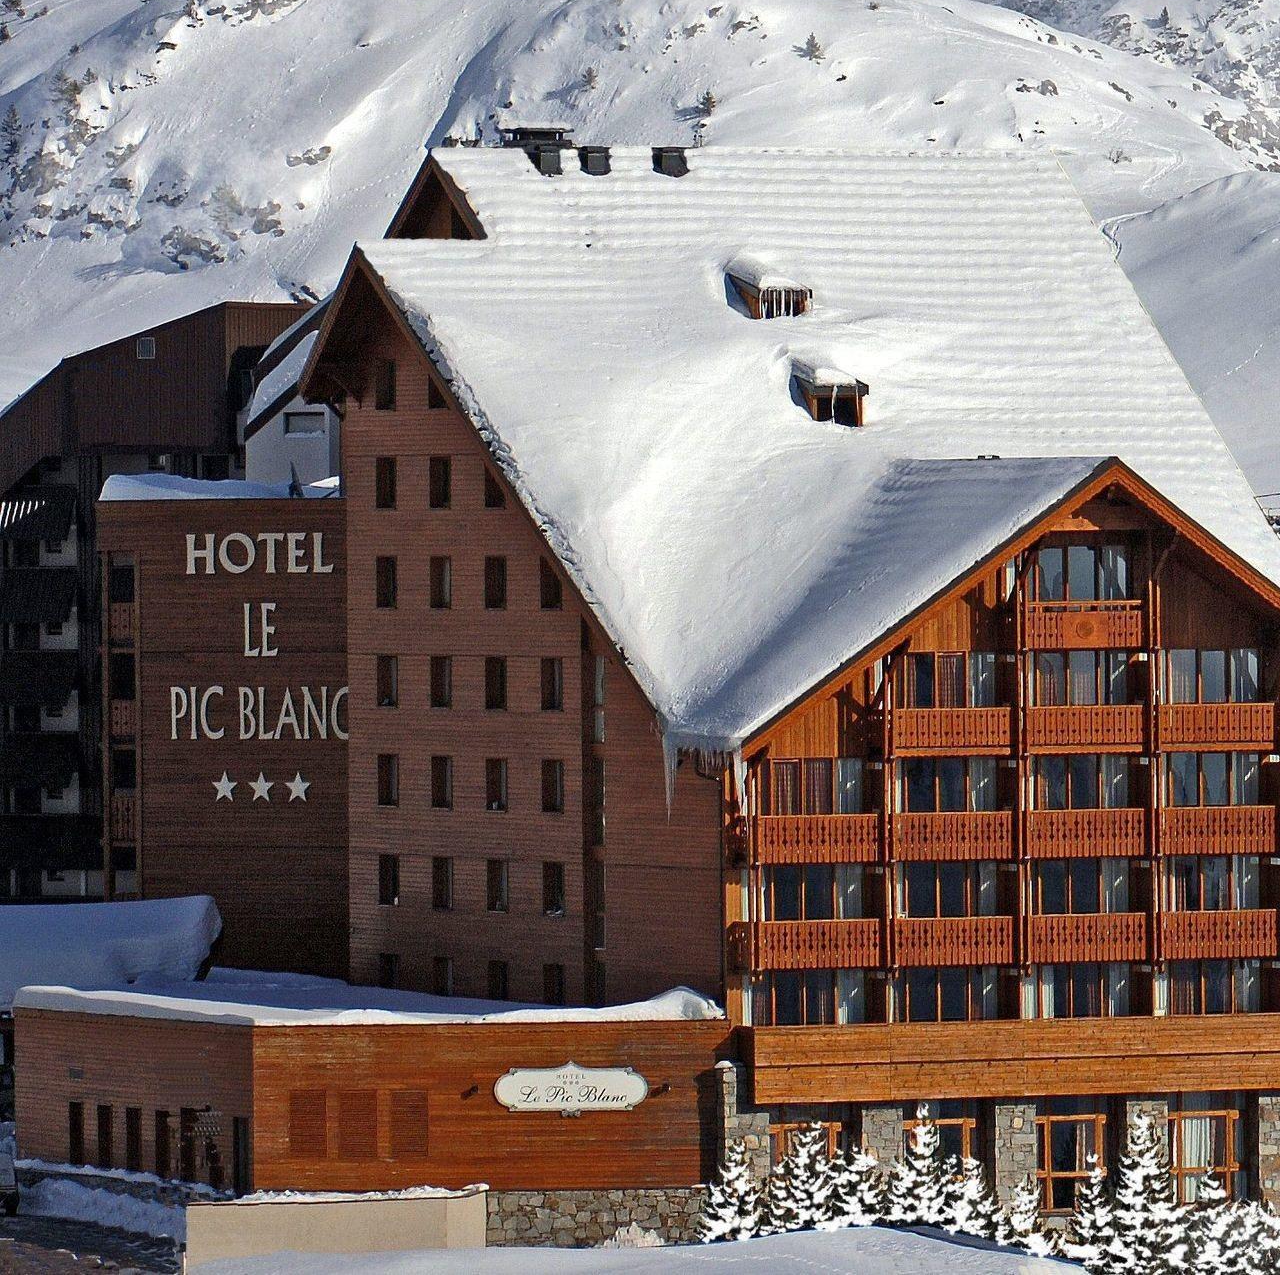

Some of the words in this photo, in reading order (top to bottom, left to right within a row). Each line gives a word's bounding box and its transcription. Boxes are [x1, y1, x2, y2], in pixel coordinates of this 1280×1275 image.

[185, 532, 335, 575] HOTEL
[243, 602, 279, 657] LE
[169, 685, 226, 741] PIC
[518, 1085, 541, 1103] Le
[545, 1085, 574, 1103] Pic
[577, 1085, 628, 1103] Blanc
